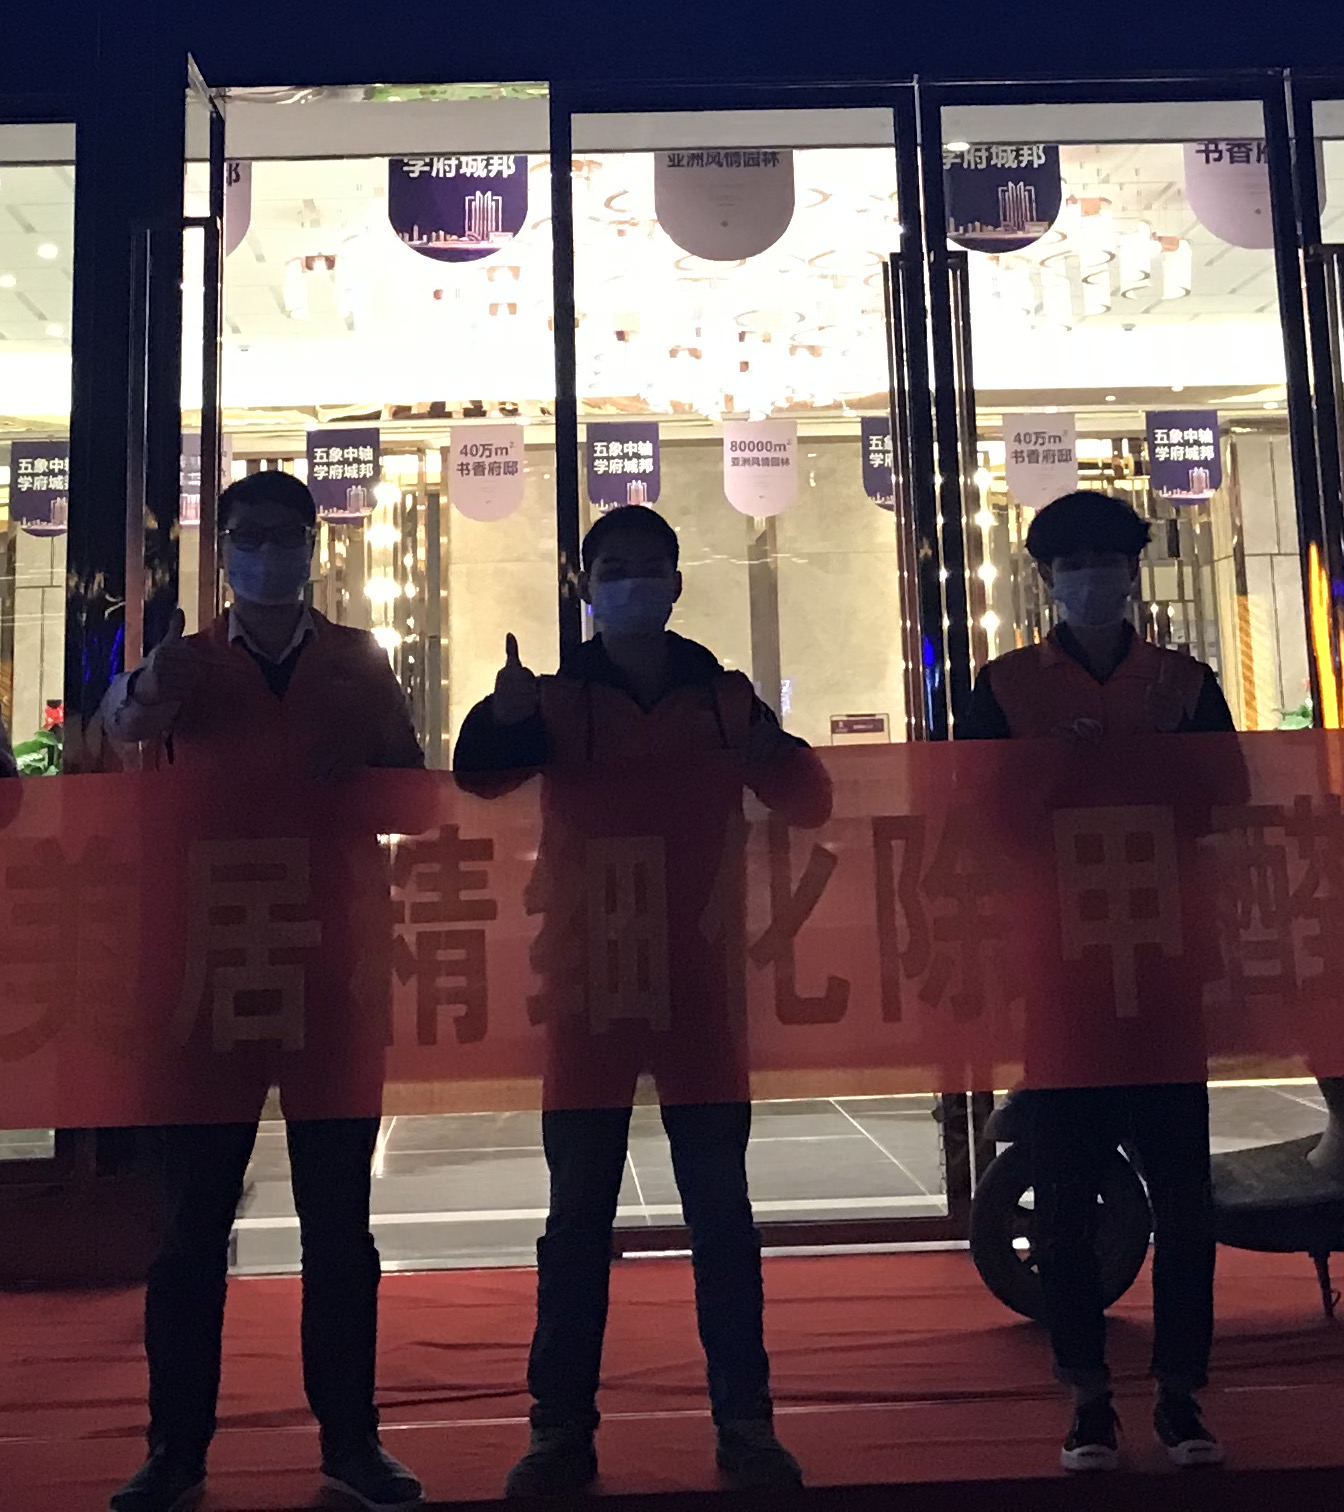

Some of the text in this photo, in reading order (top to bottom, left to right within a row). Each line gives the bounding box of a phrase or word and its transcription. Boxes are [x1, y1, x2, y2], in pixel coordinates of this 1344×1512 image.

[1154, 428, 1213, 444] 五象中轴
[313, 446, 374, 463] 五象中轴
[593, 441, 654, 457] 五象中轴
[1155, 445, 1215, 461] 学府城邦
[313, 464, 374, 481] 学府城邦
[456, 460, 519, 477] 书香府邸
[593, 458, 654, 475] 学府城邦
